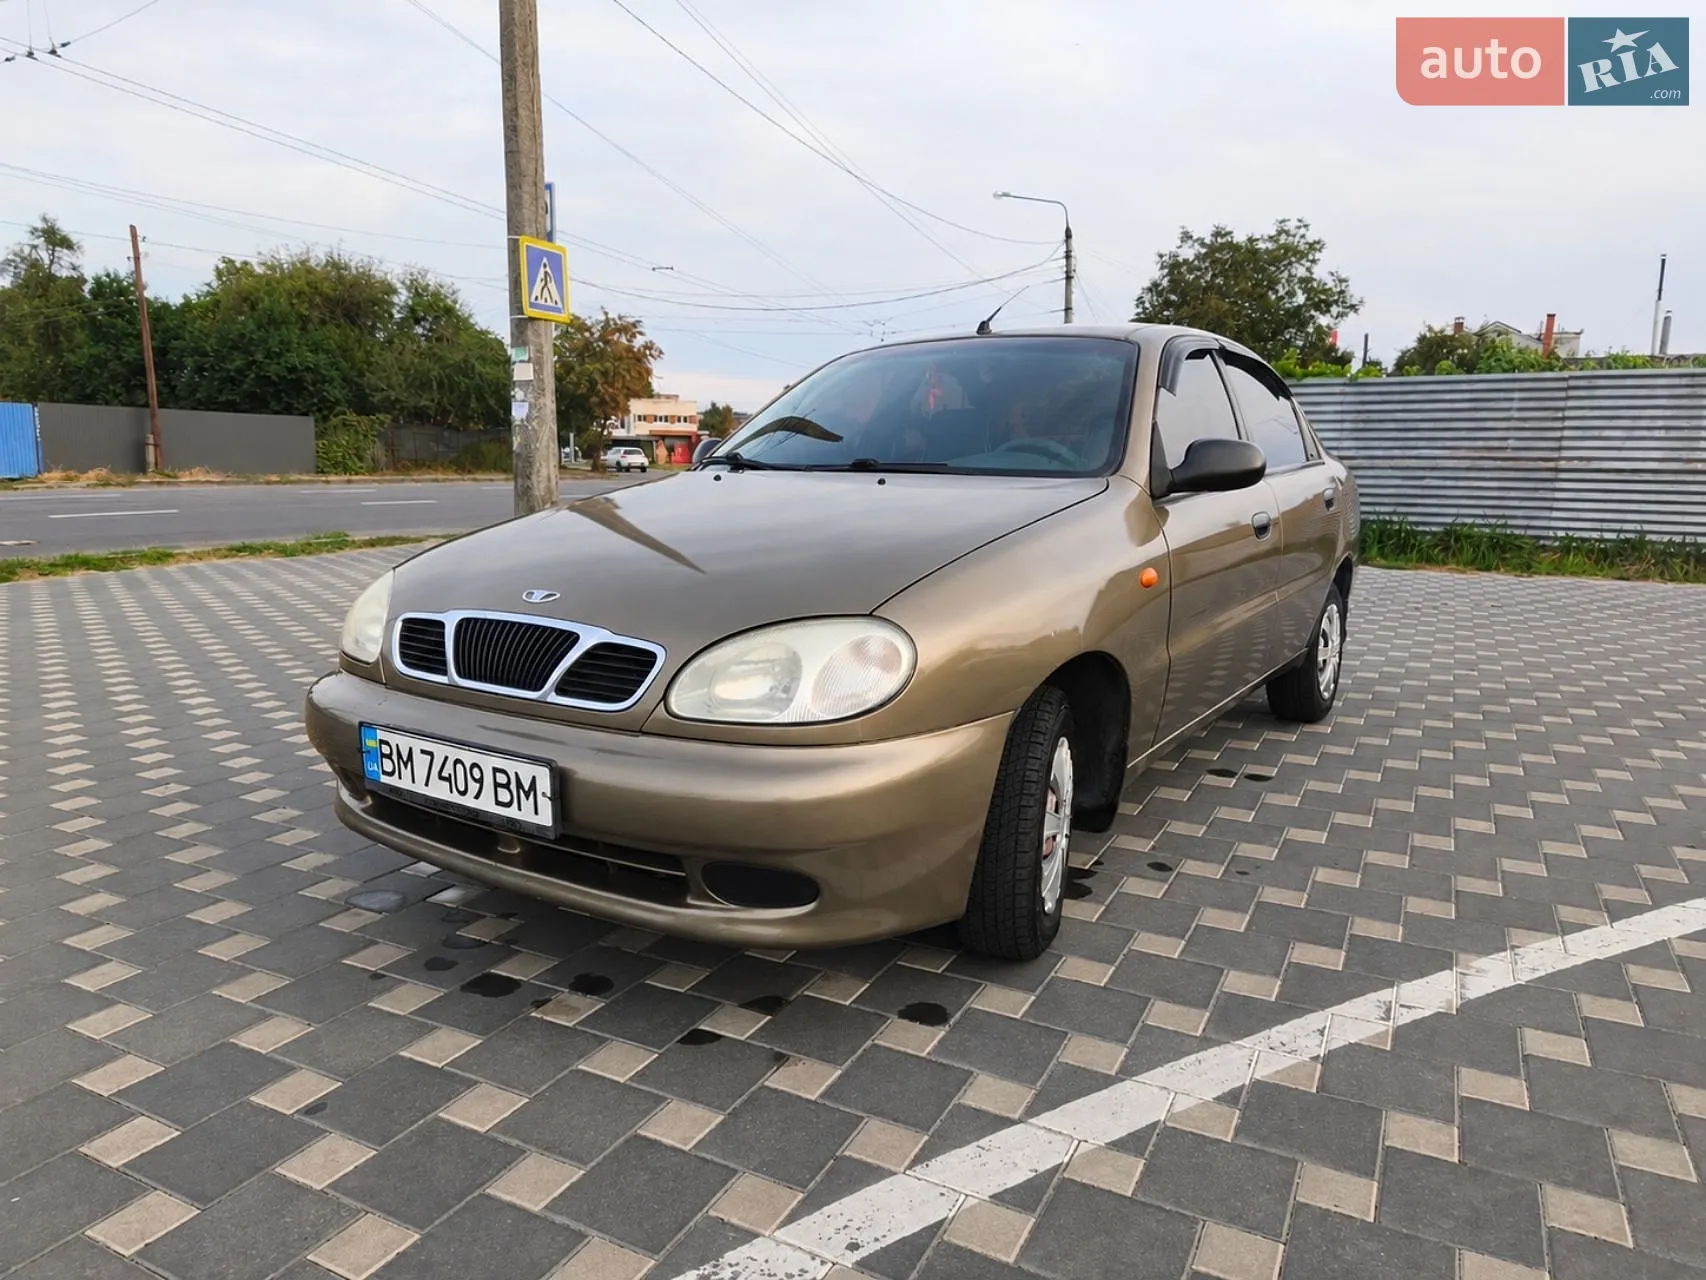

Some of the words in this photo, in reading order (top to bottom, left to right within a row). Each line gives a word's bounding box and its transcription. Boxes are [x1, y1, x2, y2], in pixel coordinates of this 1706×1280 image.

[367, 762, 378, 772] UA
[379, 739, 416, 784] BM
[420, 749, 484, 800] 7409
[492, 766, 539, 816] BM
